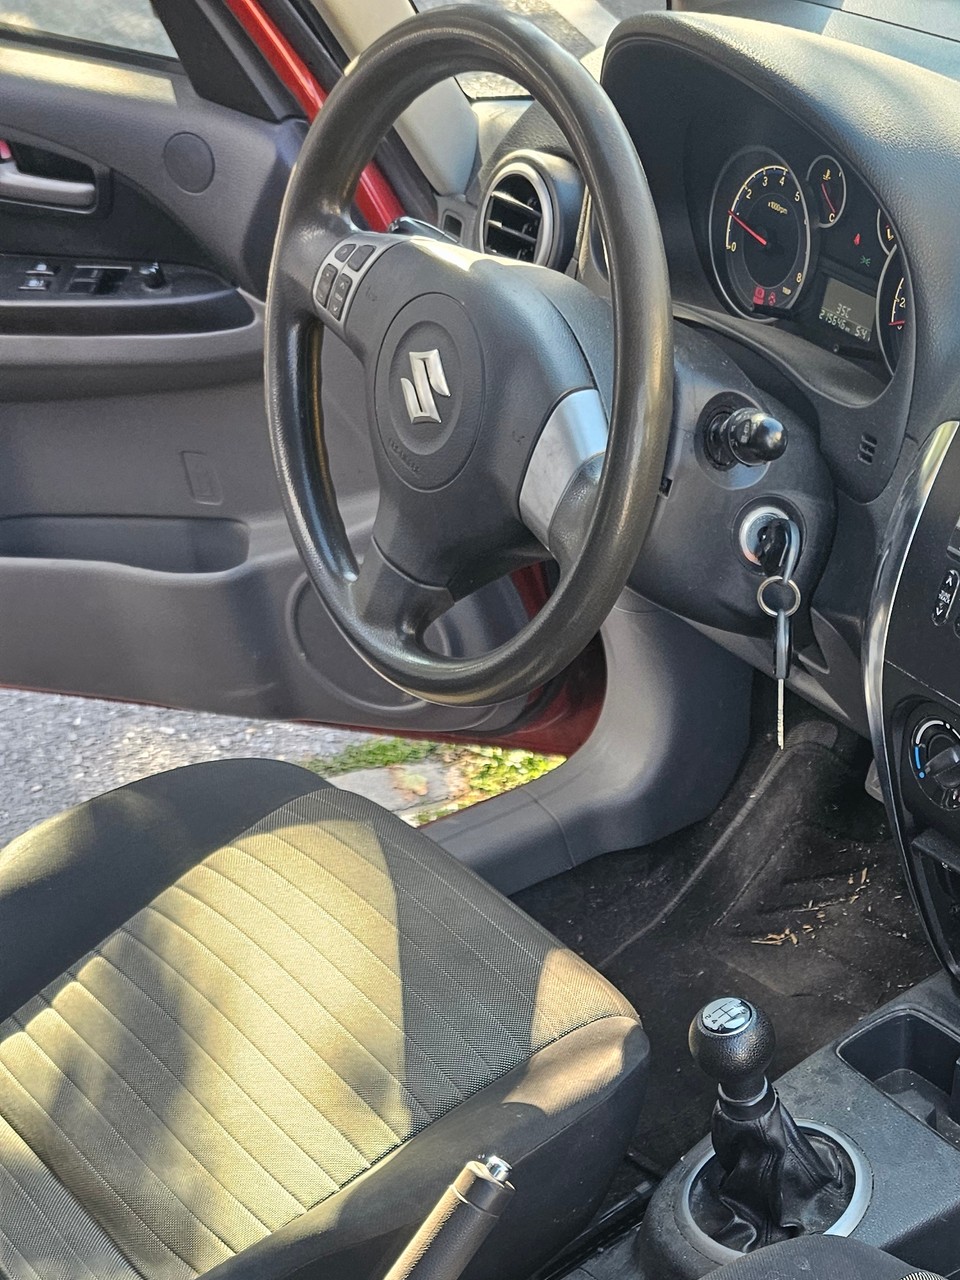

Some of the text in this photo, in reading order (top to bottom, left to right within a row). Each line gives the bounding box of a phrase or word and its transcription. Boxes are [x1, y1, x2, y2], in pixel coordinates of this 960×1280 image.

[762, 176, 768, 187] 3
[779, 176, 785, 187] 4
[746, 188, 752, 199] 2
[794, 191, 801, 202] 5
[731, 241, 737, 252] 0
[796, 272, 803, 283] 8
